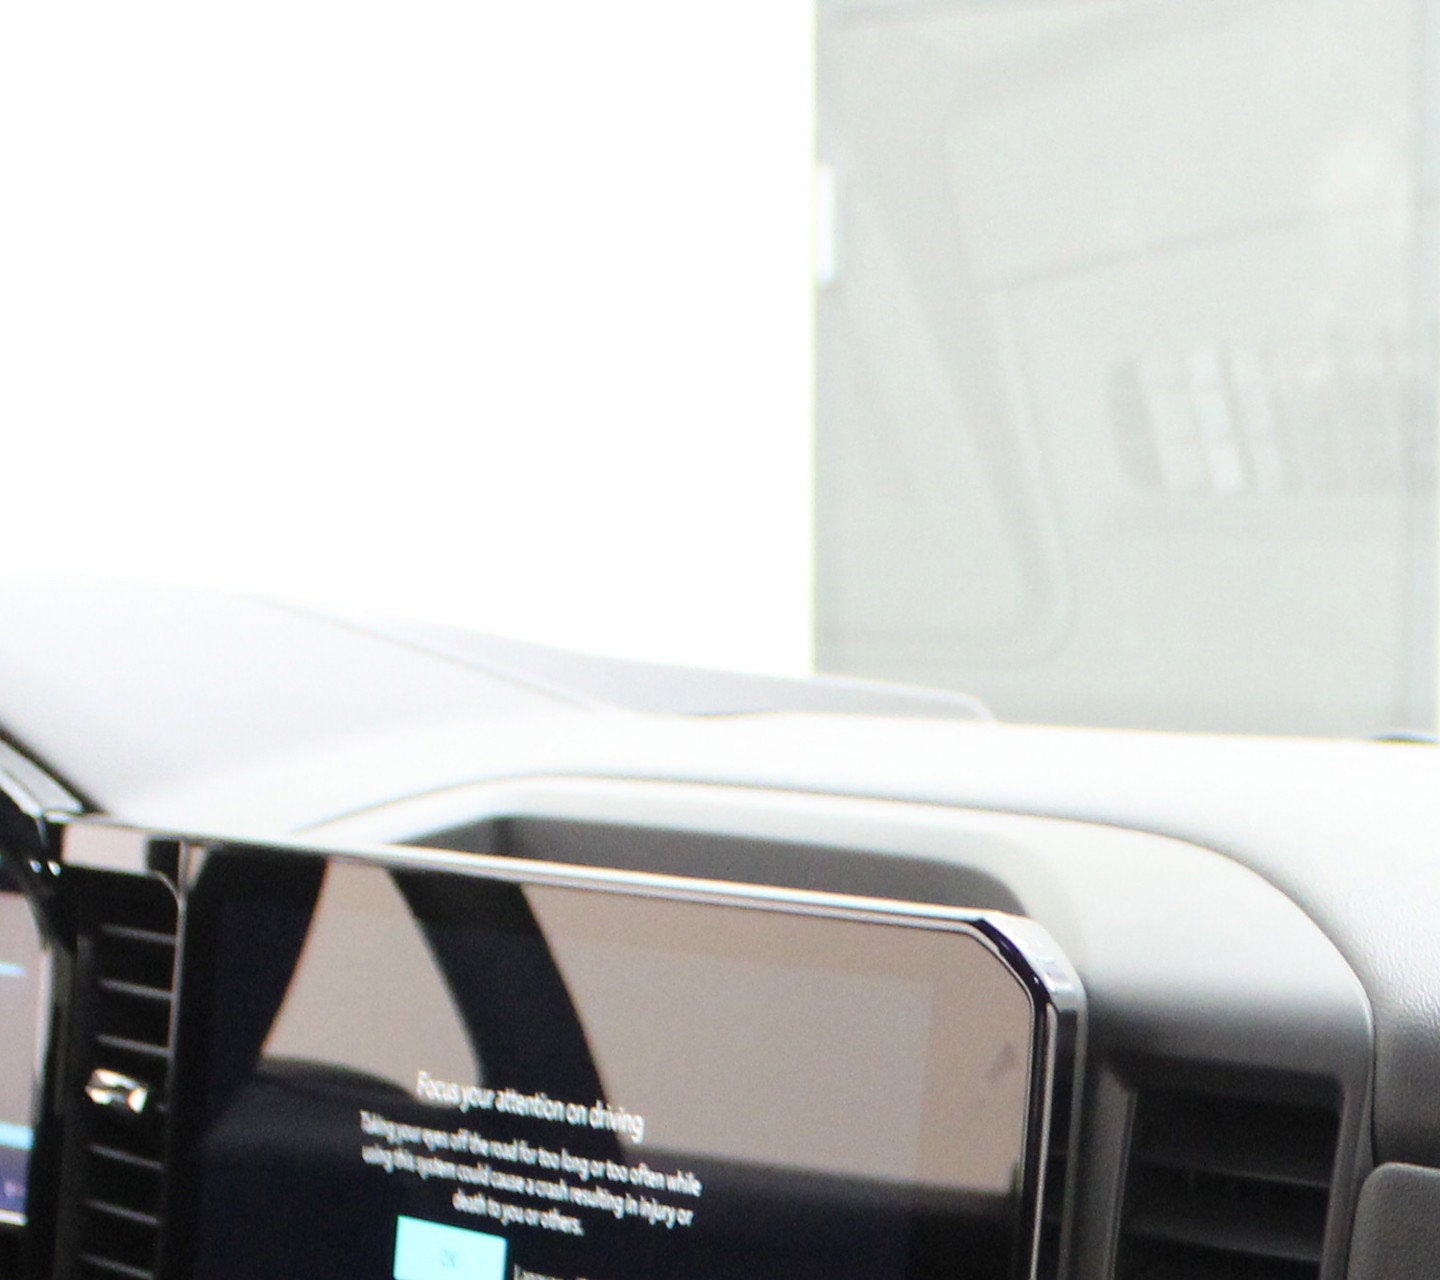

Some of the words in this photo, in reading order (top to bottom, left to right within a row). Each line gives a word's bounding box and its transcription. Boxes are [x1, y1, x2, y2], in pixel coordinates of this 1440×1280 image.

[417, 1070, 459, 1101] Focus
[460, 1084, 495, 1112] your
[495, 1088, 565, 1122] attention
[566, 1101, 588, 1125] on
[589, 1100, 644, 1143] driving
